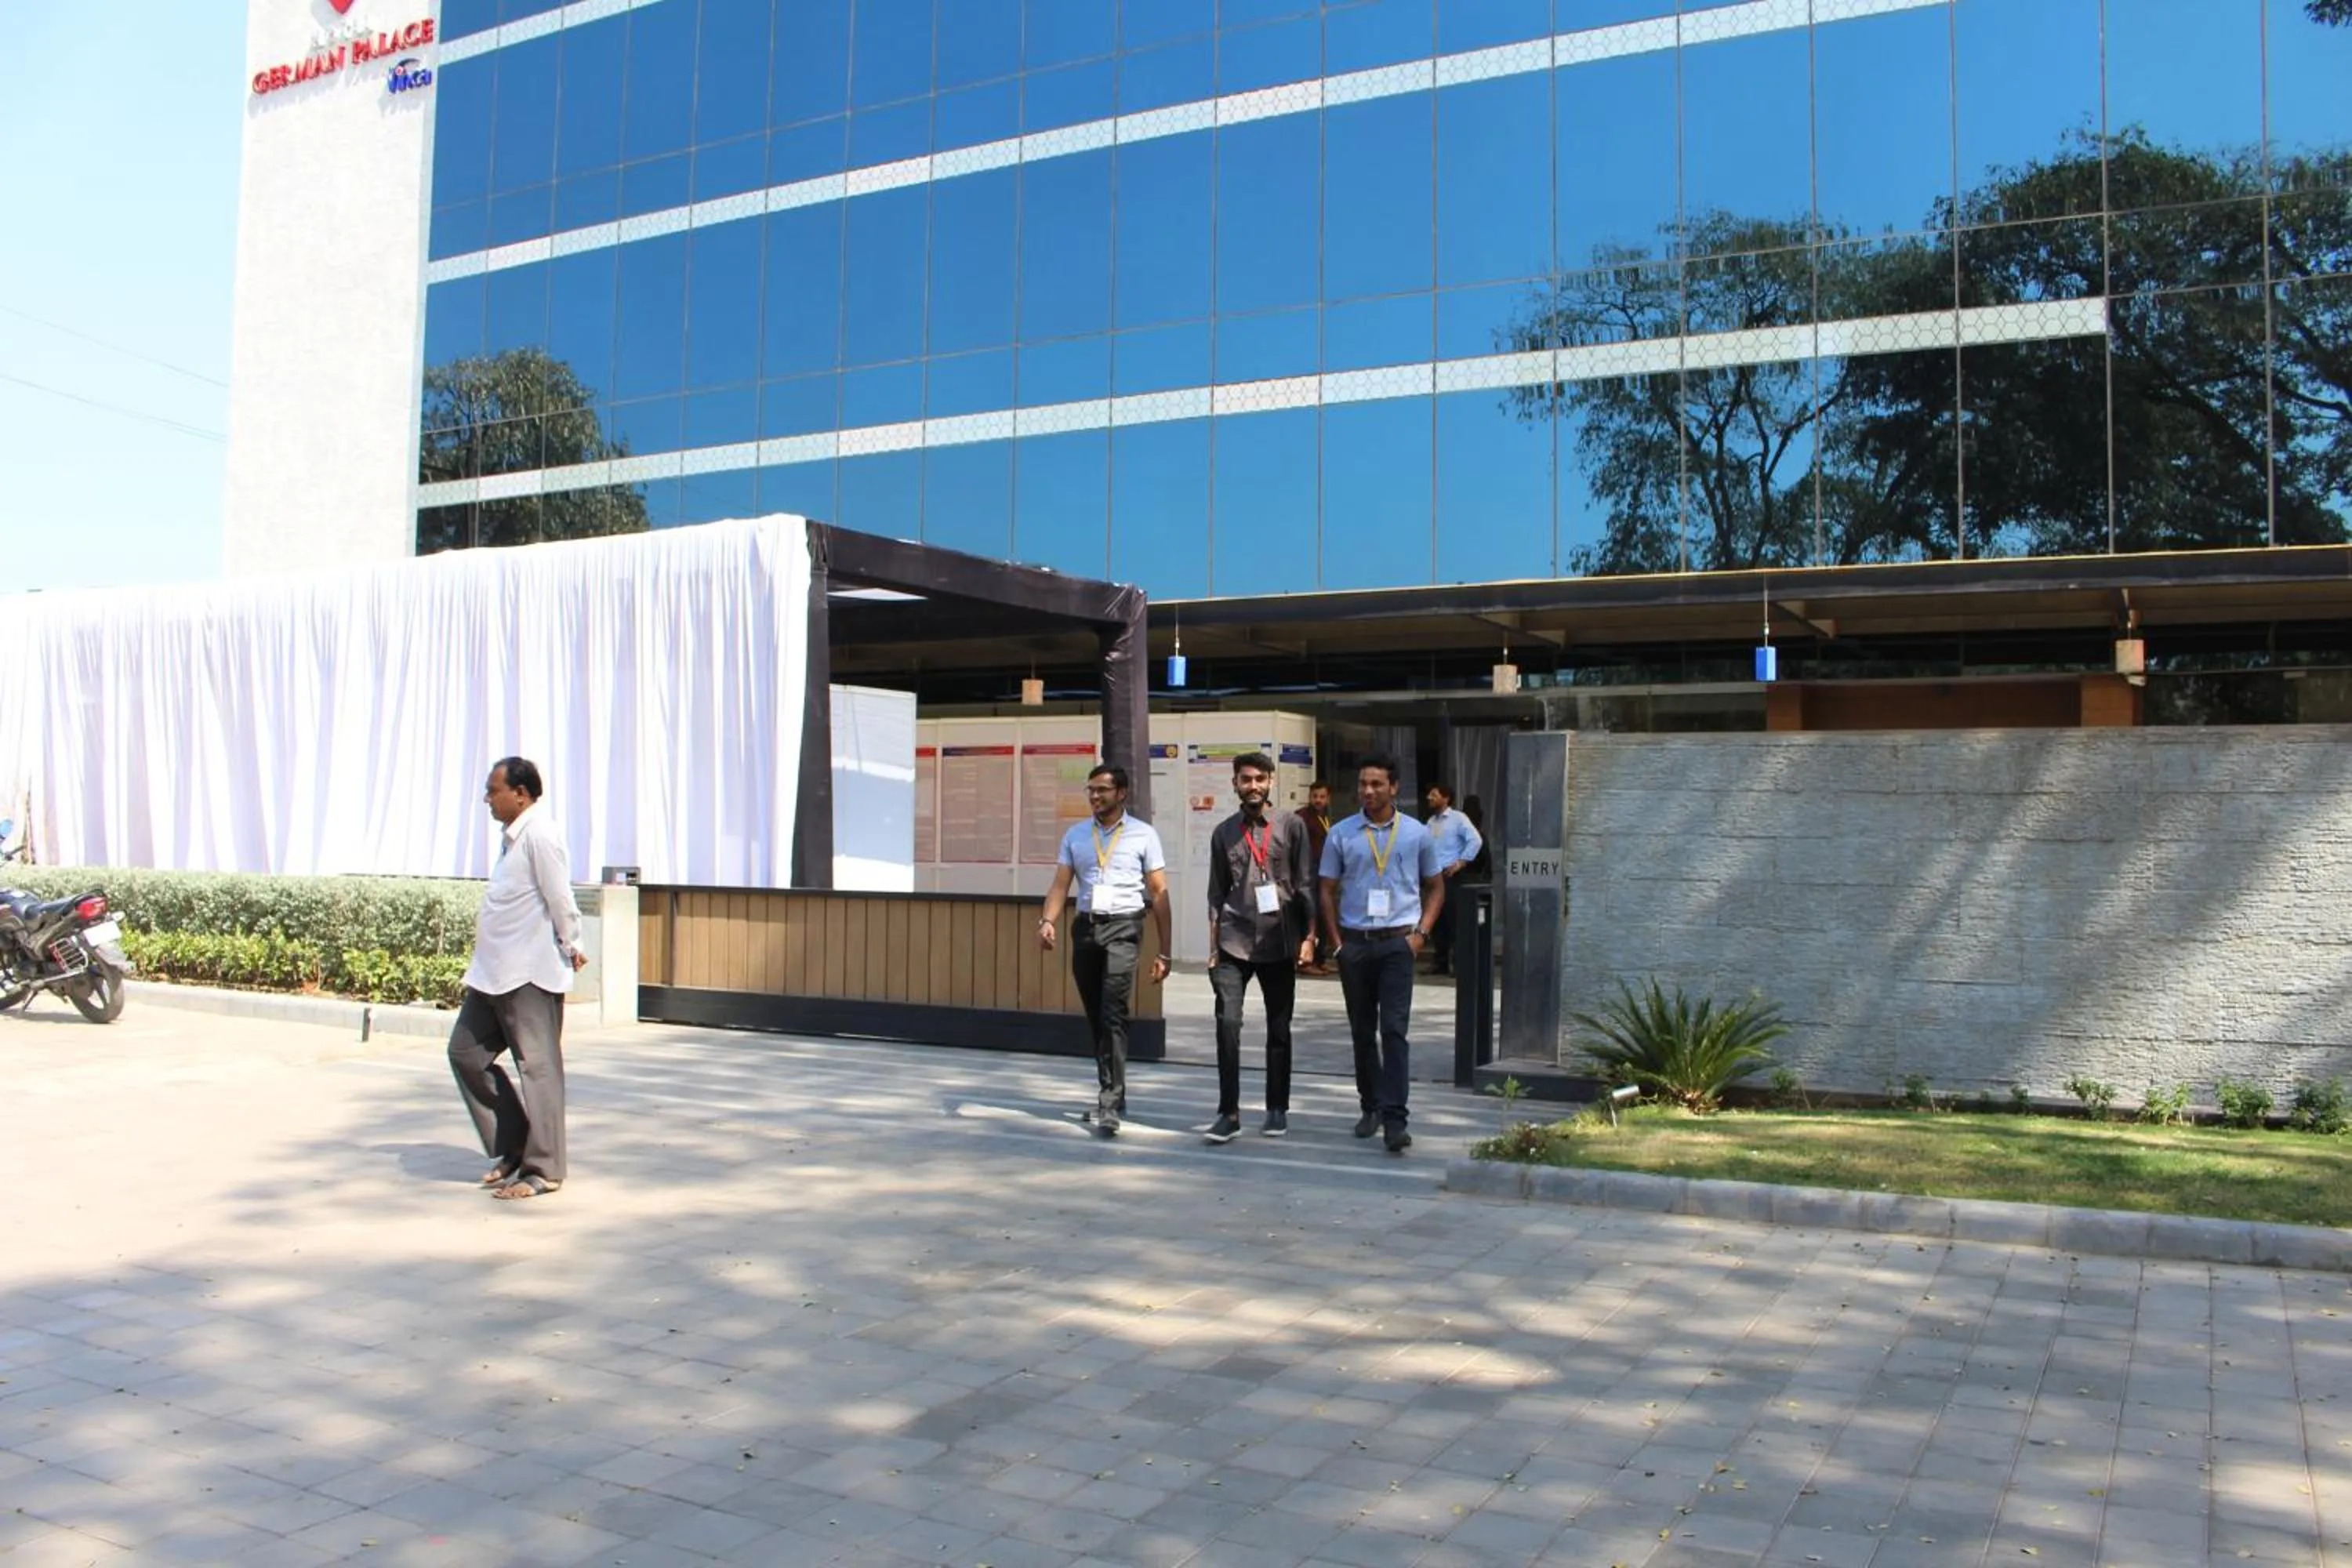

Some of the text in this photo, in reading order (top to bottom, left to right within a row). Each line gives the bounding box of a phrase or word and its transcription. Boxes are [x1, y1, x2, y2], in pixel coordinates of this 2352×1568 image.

[252, 45, 346, 94] GERMAN
[352, 19, 434, 64] PALACE
[1510, 861, 1559, 876] ENTRY
